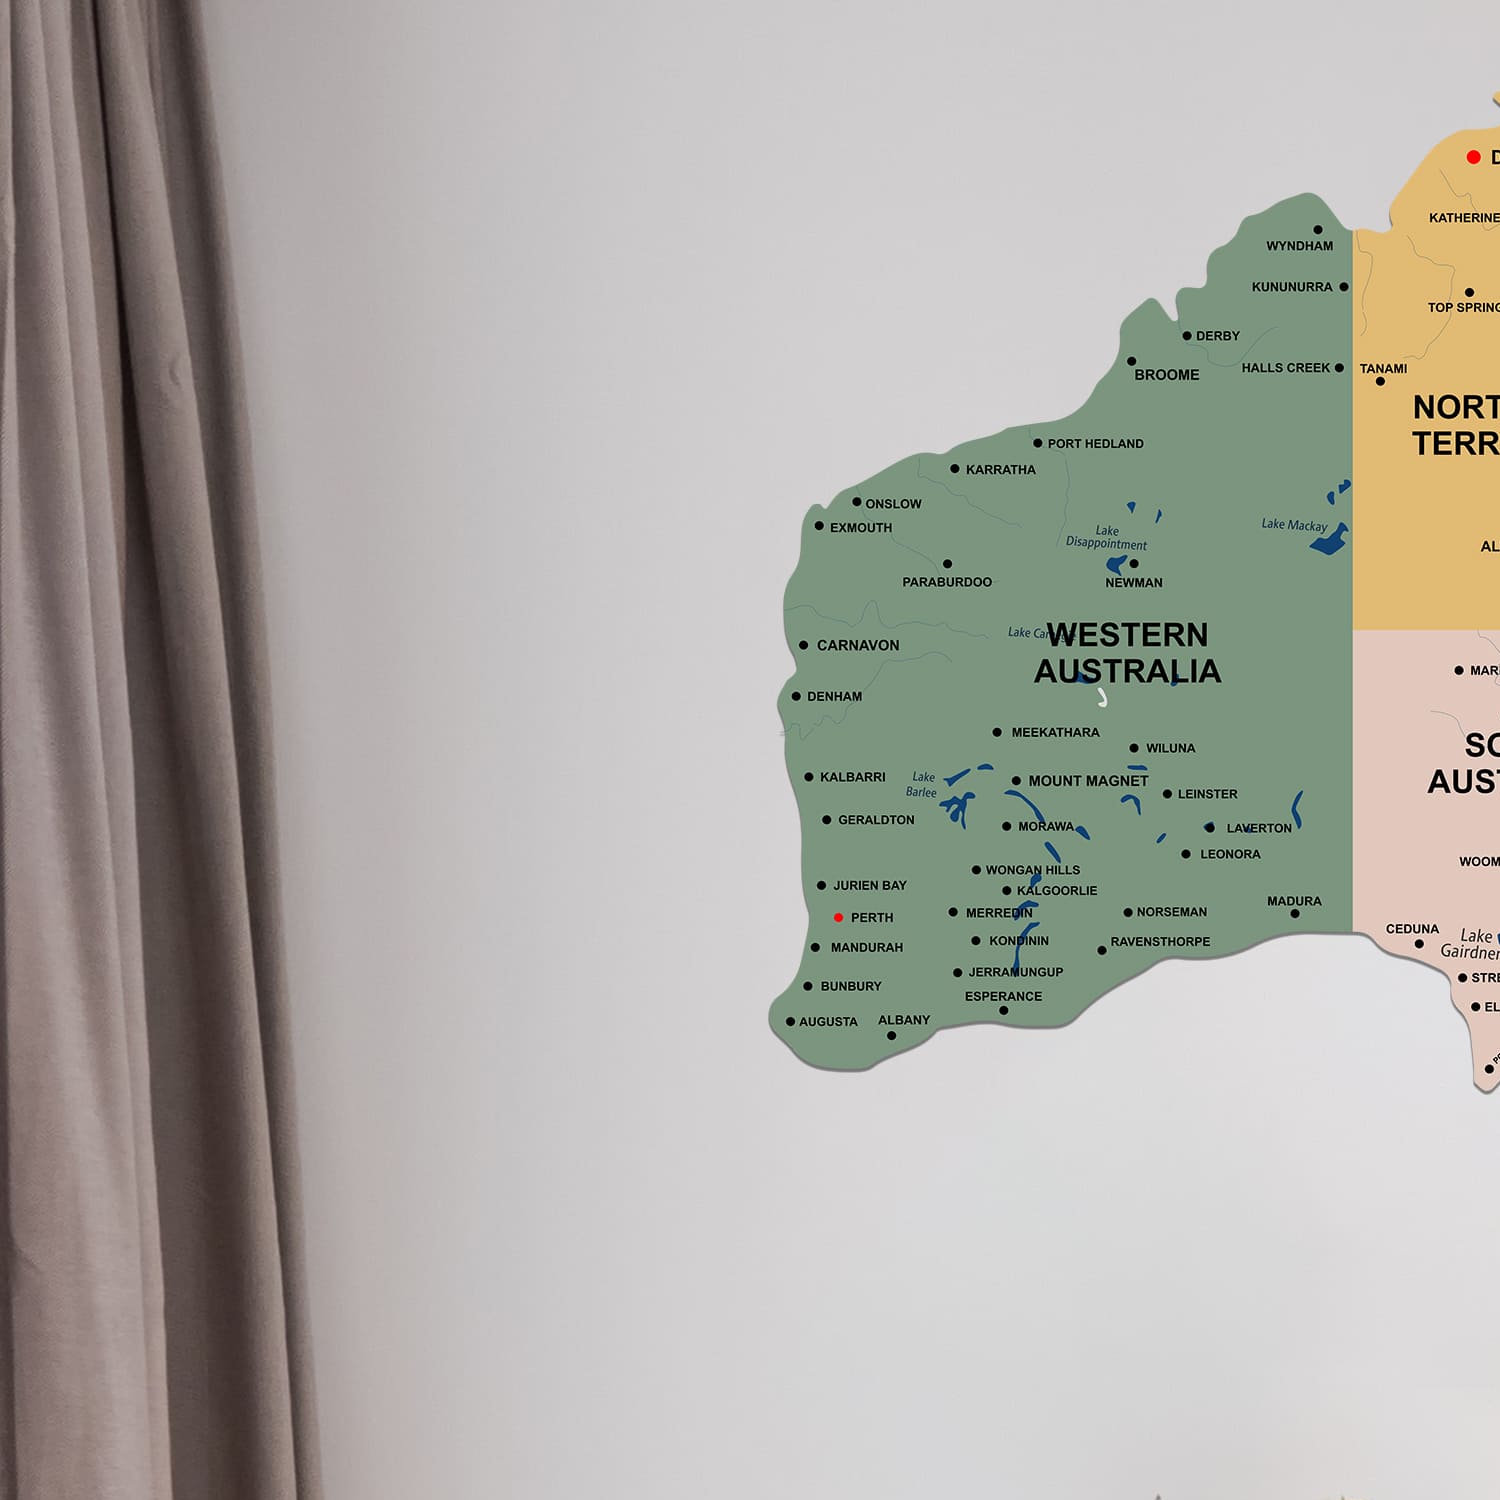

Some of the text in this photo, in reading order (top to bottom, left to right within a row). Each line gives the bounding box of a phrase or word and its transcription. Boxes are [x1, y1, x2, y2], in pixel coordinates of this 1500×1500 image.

[1430, 213, 1500, 222] KATHERINE
[1267, 241, 1333, 250] WYNDHAM
[1253, 282, 1332, 292] KUNUNURRA
[1429, 303, 1453, 312] TOP
[1197, 331, 1240, 340] DERBY
[1243, 363, 1330, 372] HALLS CREEK
[1360, 364, 1406, 373] TANAMI
[1135, 369, 1199, 380] BROOME
[1049, 439, 1143, 448] PORT HEDLAND
[967, 465, 1036, 474] KARRATHA
[866, 499, 921, 509] ONSLOW
[831, 523, 892, 532] EXMOUTH
[1096, 525, 1119, 536] Lake
[1262, 519, 1328, 534] Lake Mackay
[1066, 536, 1147, 551] Disappointment
[903, 577, 992, 587] PARABURDOO
[1106, 578, 1162, 587] NEWMAN
[1008, 628, 1033, 639] Lake
[1046, 622, 1207, 647] WESTERN
[818, 640, 899, 651] CARNAVON
[1034, 659, 1221, 683] AUSTRALIA
[808, 692, 862, 701] DENHAM
[1013, 728, 1100, 737] MEEKATHARA
[1147, 744, 1195, 753] WILUNA
[821, 772, 885, 782] KALBARRI
[913, 771, 935, 783] Lake
[1030, 775, 1148, 786] MOUNT MAGNET
[906, 786, 937, 799] Barlee
[1179, 789, 1237, 798] LEINSTER
[839, 815, 914, 824] GERALDTON
[1019, 821, 1074, 831] MORAWA
[1228, 824, 1291, 833] LAVERTON
[1201, 850, 1260, 859] LEONORA
[986, 865, 1080, 875] WONGAN HILLS
[834, 881, 906, 890] JURIEN BAY
[1018, 886, 1097, 895] KALGOORLIE
[1268, 896, 1322, 906] MADURA
[967, 908, 1032, 918] MERREDIN
[1138, 907, 1207, 916] NORSEMAN
[852, 913, 893, 922] PERTH
[1387, 924, 1439, 933] CEDUNA
[990, 936, 1048, 946] KONDININ
[1461, 929, 1493, 944] Lake
[1112, 937, 1210, 946] RAVENSTHORPE
[832, 943, 902, 952] MANDURAH
[969, 966, 1063, 977] JERRAMUNGUP
[822, 982, 881, 991] BUNBURY
[966, 992, 1042, 1001] ESPERANCE
[800, 1017, 857, 1026] AUGUSTA
[879, 1015, 930, 1024] ALBANY
